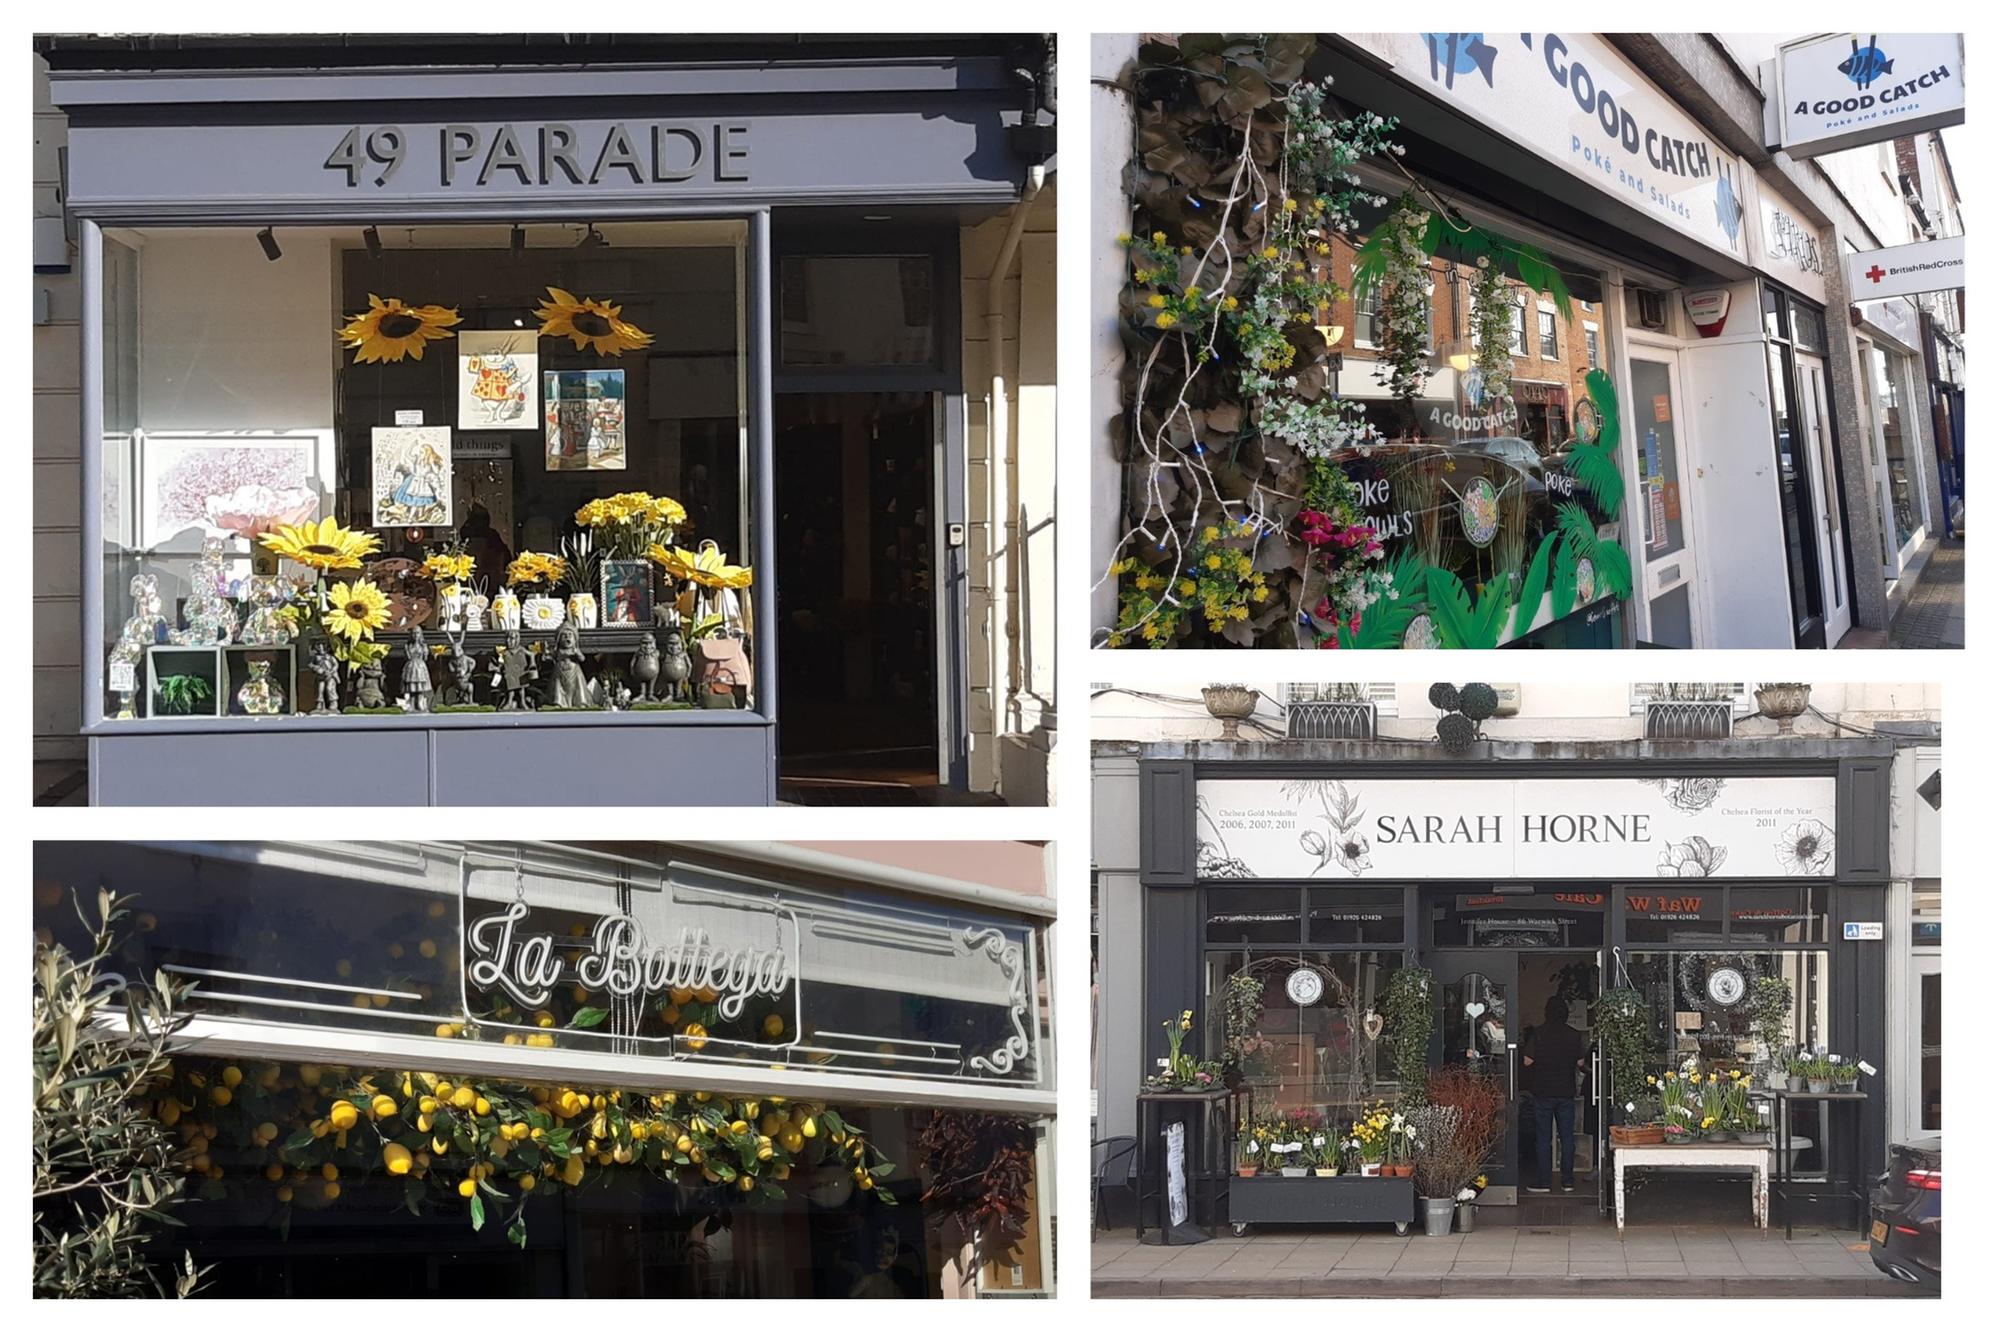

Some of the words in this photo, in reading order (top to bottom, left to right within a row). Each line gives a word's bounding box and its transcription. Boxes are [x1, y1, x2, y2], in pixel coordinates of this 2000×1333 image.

[1794, 102, 1808, 115] A
[1812, 95, 1875, 115] GOOD
[1879, 65, 1950, 104] CATCH
[1544, 33, 1640, 155] GOOD
[1645, 128, 1711, 178] CATCH
[1857, 112, 1877, 122] and
[1882, 103, 1920, 116] Salads
[323, 124, 407, 187] 49
[439, 121, 752, 187] PARADE
[1571, 134, 1612, 174] Poké
[1619, 169, 1644, 193] and
[1650, 186, 1691, 219] Salads
[1429, 406, 1440, 424] A
[1443, 411, 1481, 432] GOOD
[467, 439, 504, 452] things
[1219, 809, 1246, 817] Chelsea
[1247, 809, 1265, 817] Gold
[1266, 809, 1298, 817] Medallist
[1721, 807, 1749, 815] Chelsea
[1750, 807, 1773, 815] Florist
[1774, 807, 1782, 815] of
[1783, 807, 1795, 815] the
[1796, 807, 1813, 815] Year
[1756, 818, 1777, 828] 2011
[1219, 820, 1247, 831] 2006,
[1248, 820, 1275, 831] 2007,
[1275, 820, 1296, 830] 2011
[1376, 815, 1503, 844] SARAH
[1521, 814, 1652, 844] HORNE
[471, 902, 562, 1005] La
[578, 913, 793, 1019] Bottega
